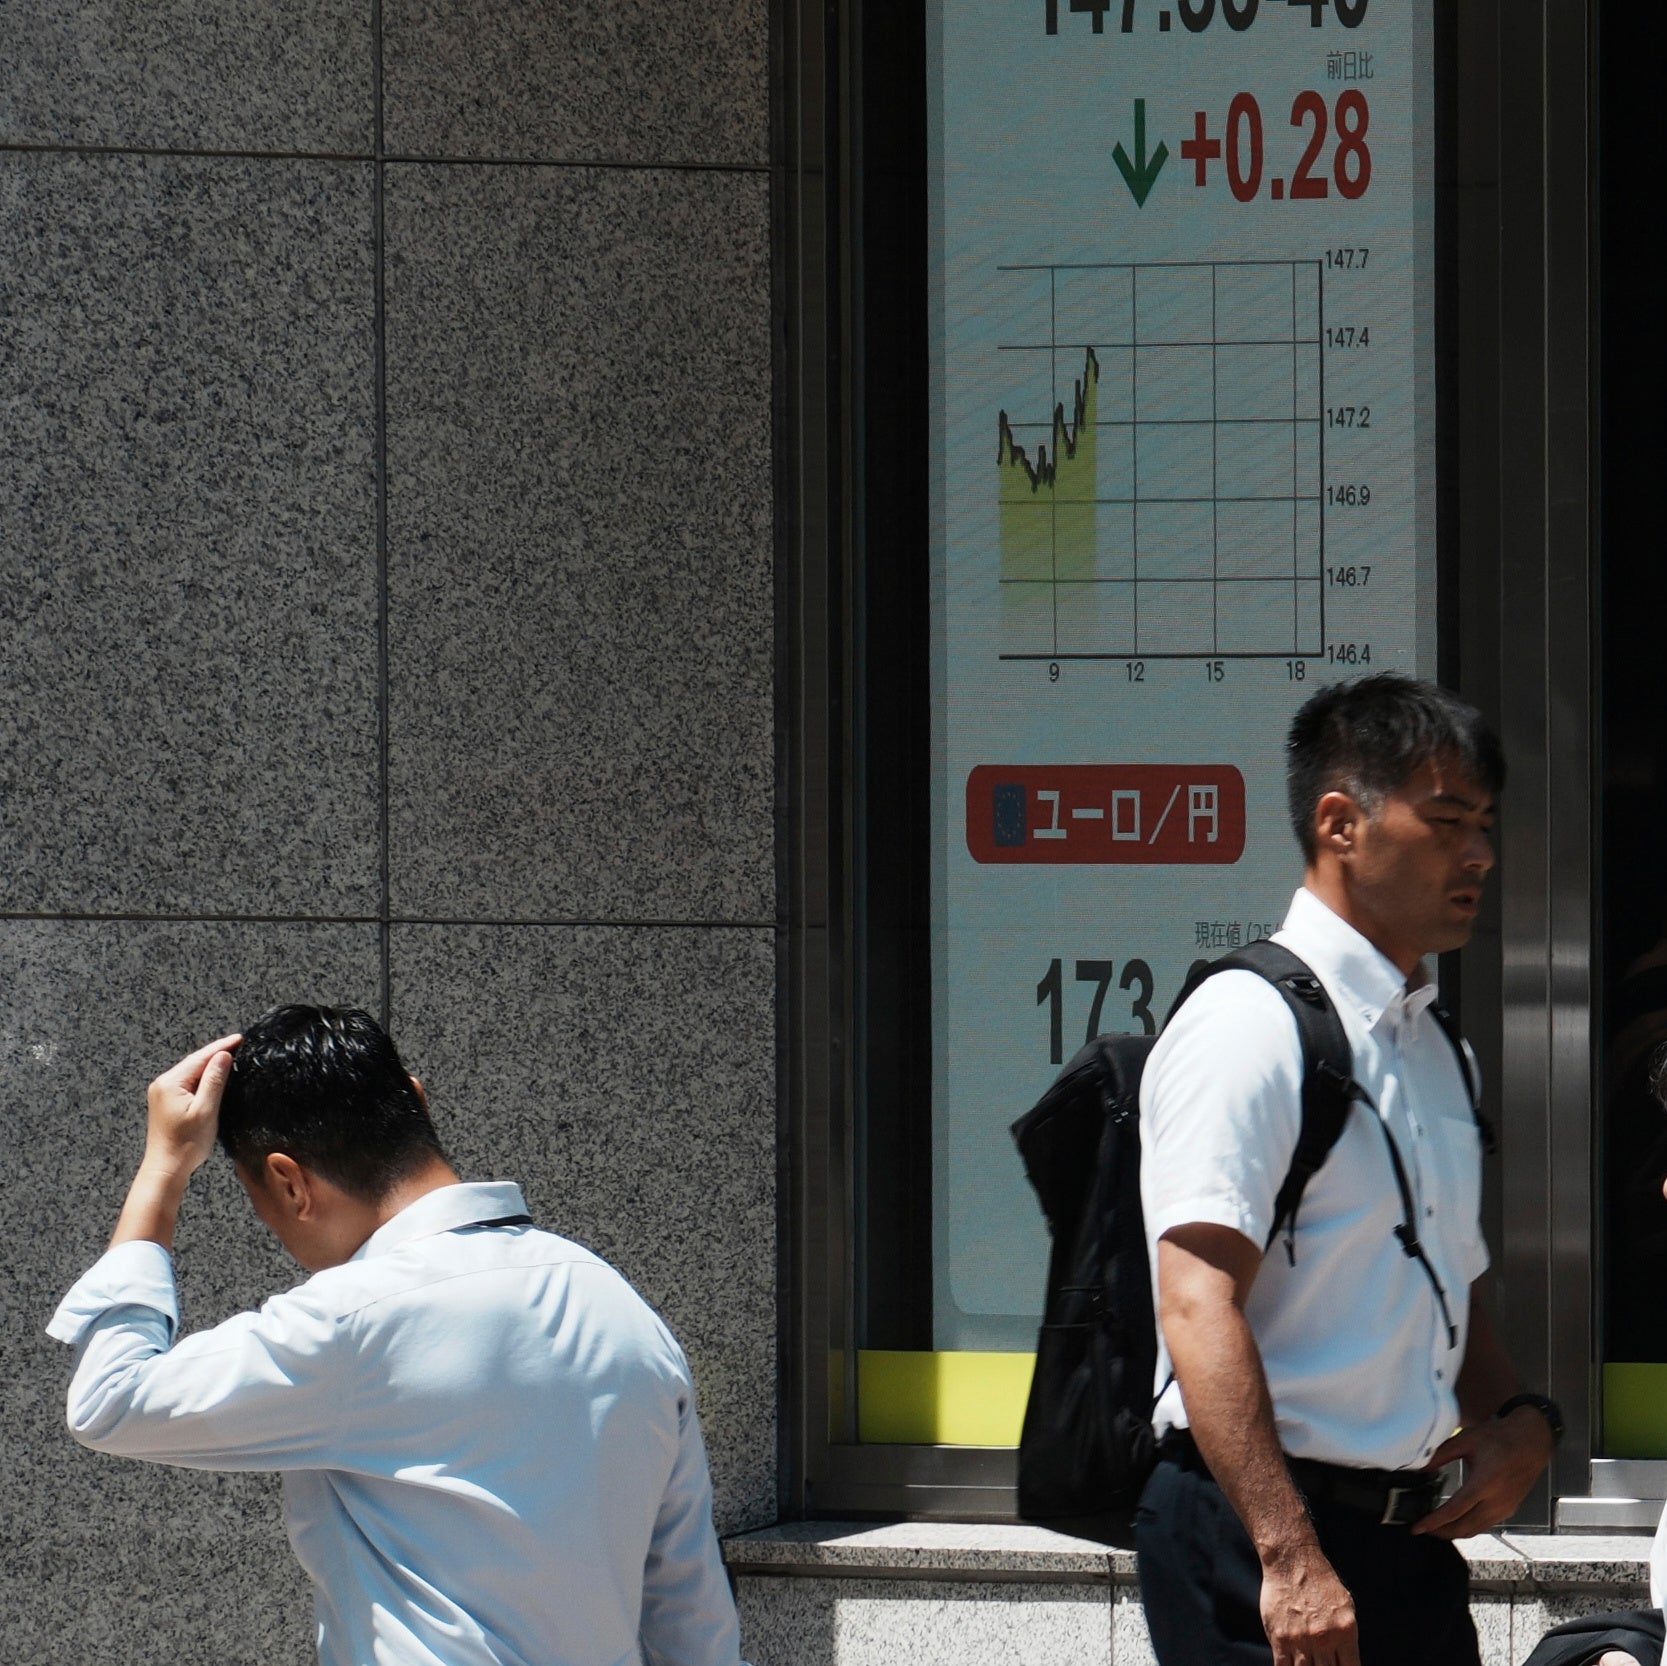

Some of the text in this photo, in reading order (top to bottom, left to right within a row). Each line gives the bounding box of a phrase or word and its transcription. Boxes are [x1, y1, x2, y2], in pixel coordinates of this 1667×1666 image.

[1327, 51, 1374, 81] 前日比
[1181, 89, 1372, 203] +0.28
[1326, 249, 1369, 269] 147.7
[1326, 327, 1369, 348] 147.4
[1327, 406, 1370, 428] 147.2
[1327, 485, 1370, 506] 146.9
[1327, 566, 1371, 586] 146.7
[1327, 644, 1371, 665] 146.4
[1049, 660, 1305, 683] 9 12 15 18
